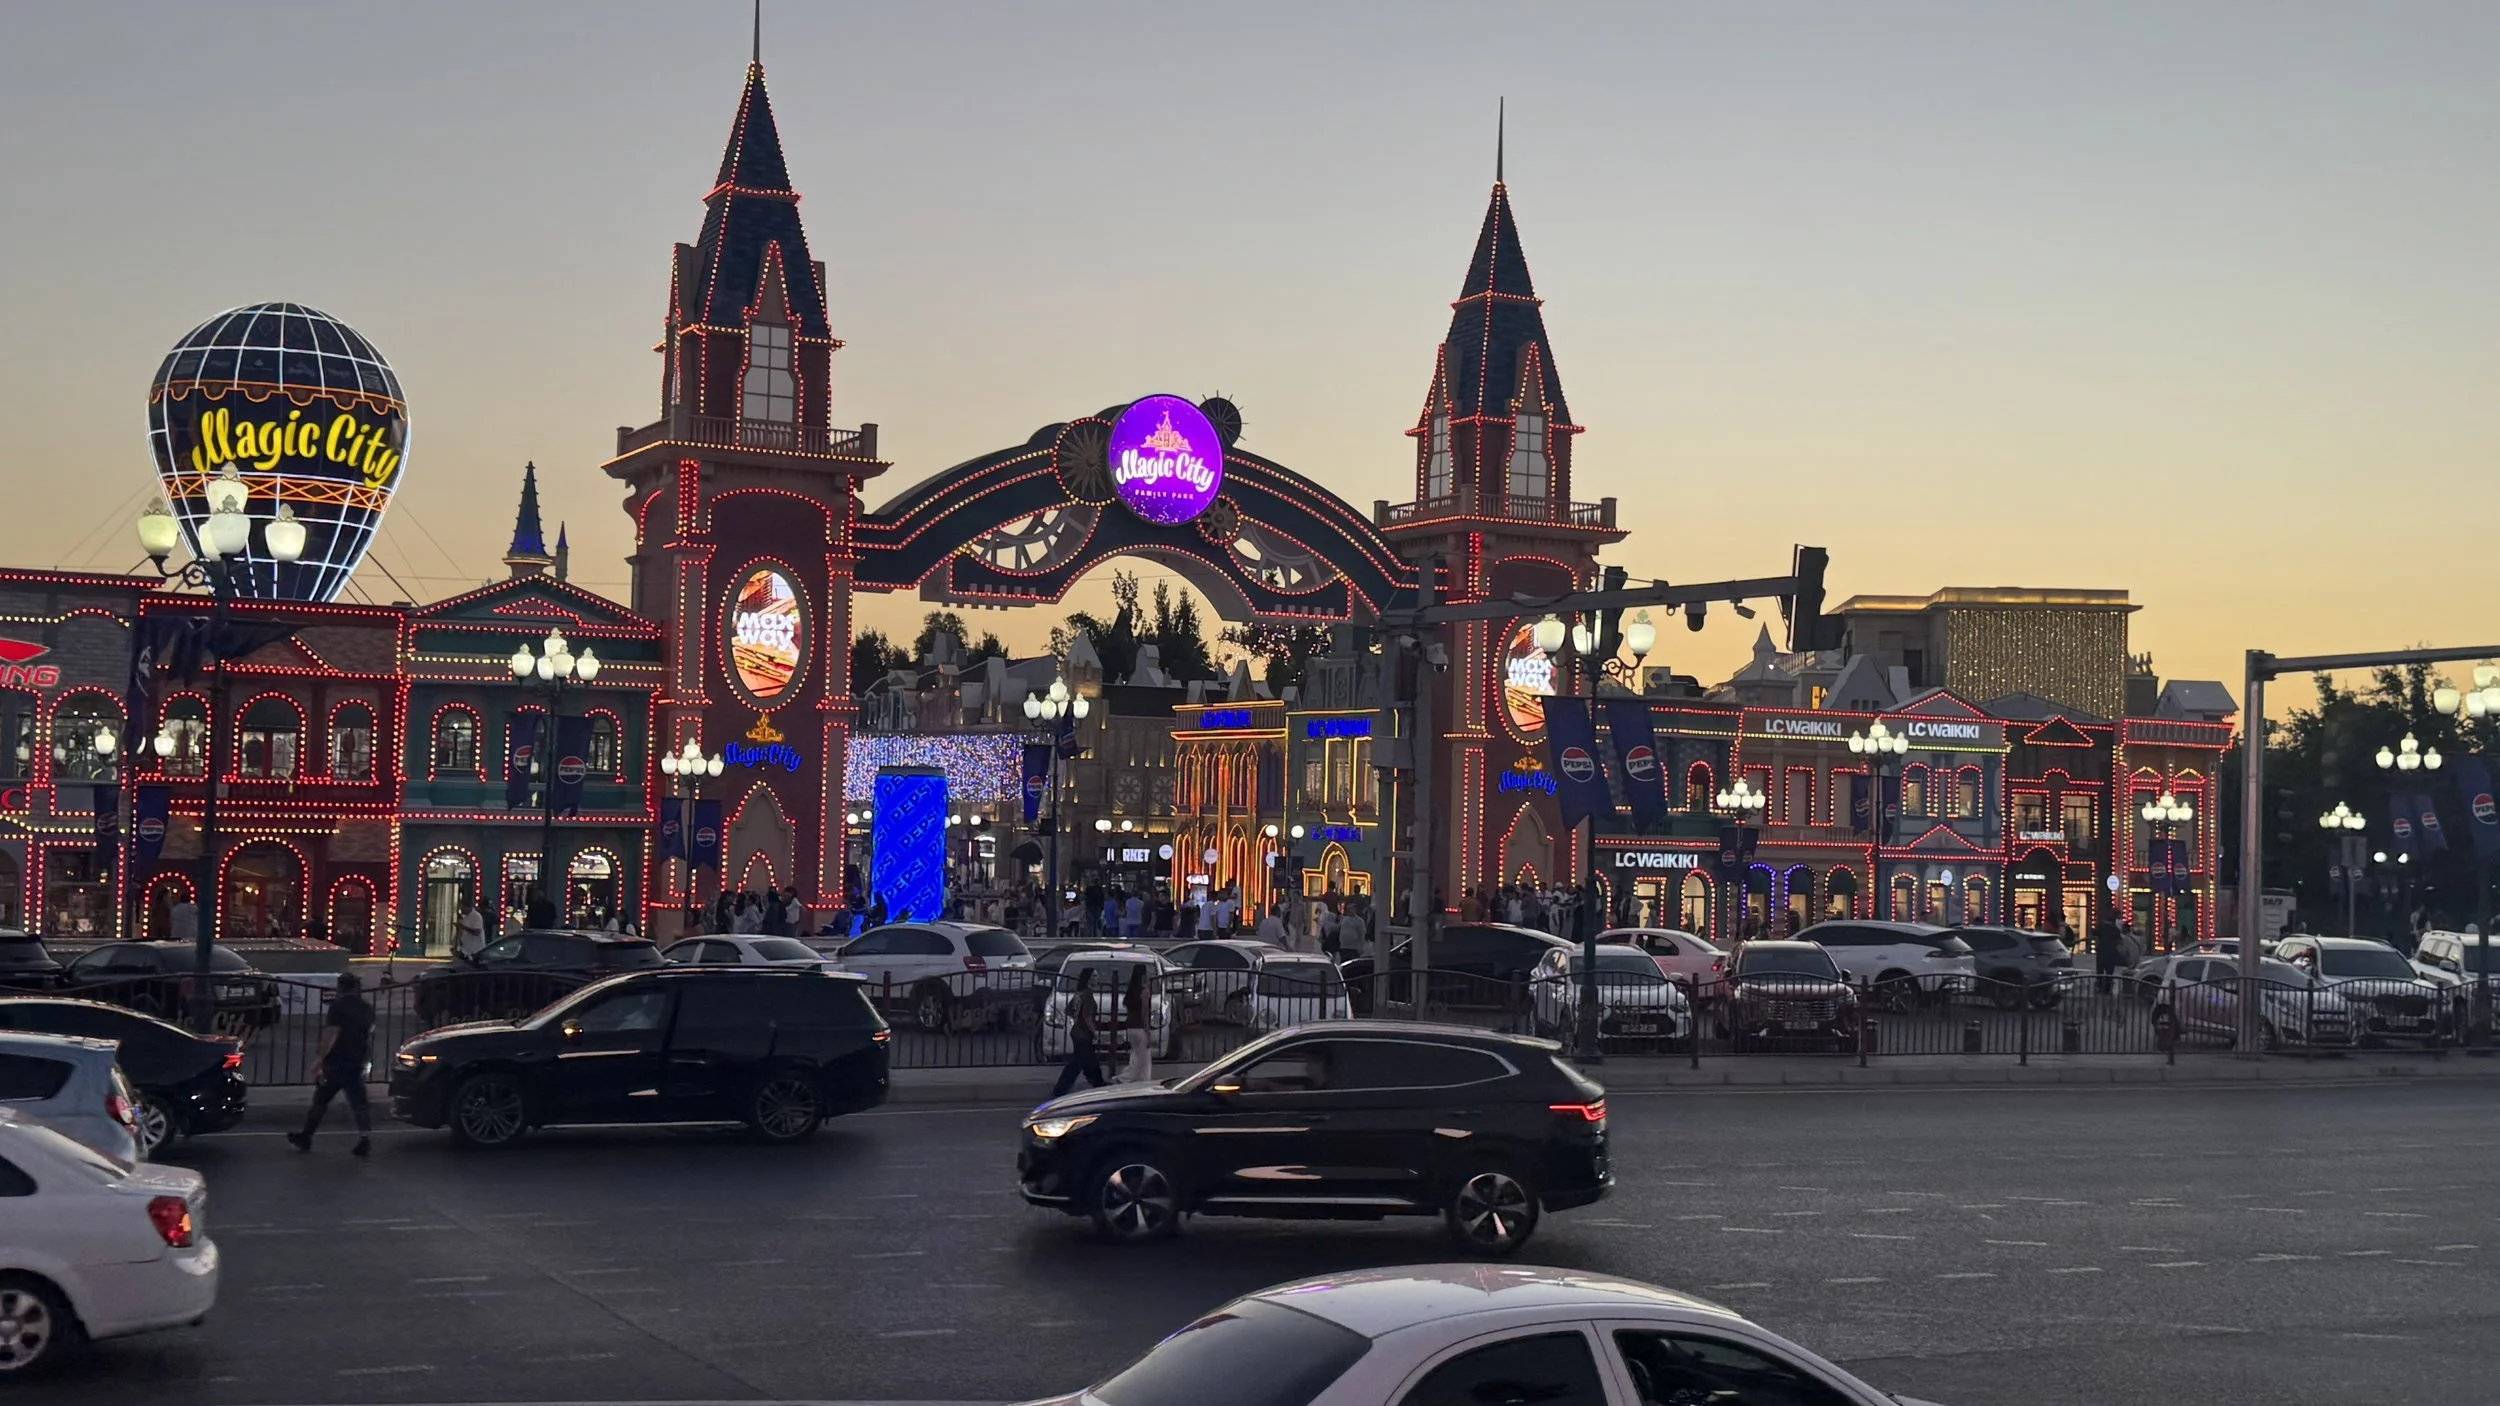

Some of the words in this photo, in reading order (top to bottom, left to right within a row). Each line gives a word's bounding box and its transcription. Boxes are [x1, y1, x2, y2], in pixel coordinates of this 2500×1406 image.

[191, 407, 320, 473] Magic
[326, 413, 401, 488] City
[1115, 449, 1173, 485] Magic
[1176, 452, 1216, 493] City
[1135, 489, 1168, 500] FAMILY
[1171, 490, 1195, 501] PARK
[768, 744, 802, 773] City
[1564, 760, 1593, 770] PEPSI
[1533, 771, 1558, 796] City
